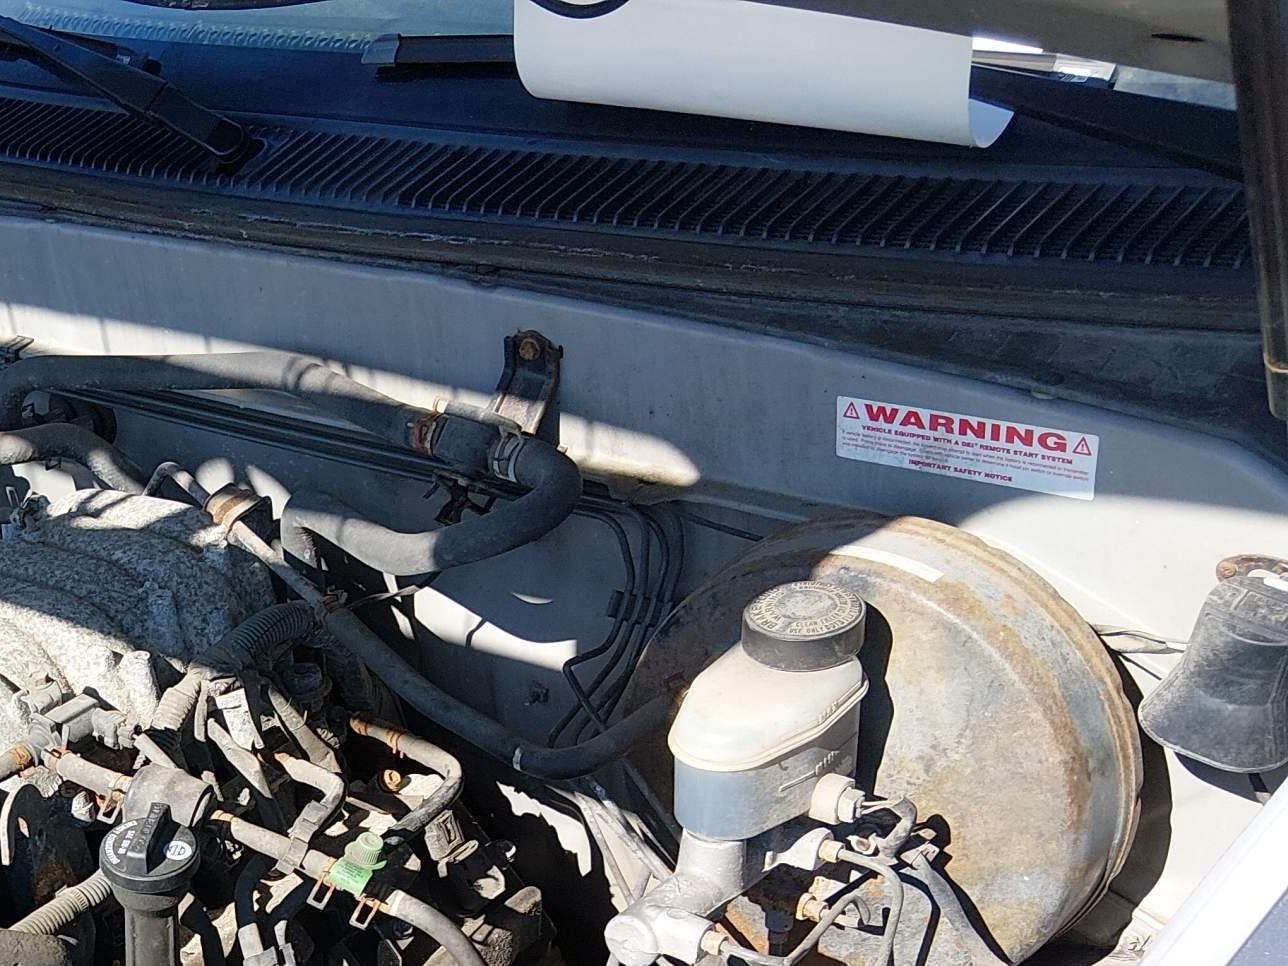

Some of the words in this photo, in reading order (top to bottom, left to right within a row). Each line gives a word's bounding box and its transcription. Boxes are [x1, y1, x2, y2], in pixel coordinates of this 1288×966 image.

[862, 425, 892, 436] VEHICLE
[894, 428, 931, 442] EQUIPPED
[933, 435, 952, 445] WITH
[979, 443, 1011, 455] REMOTE
[1013, 449, 1039, 459] START
[1041, 453, 1073, 465] SYSTEM
[864, 403, 1068, 453] WARNING
[908, 459, 951, 473] IMPORTANT
[953, 466, 982, 478] SAFETY
[984, 472, 1012, 482] NOTICE
